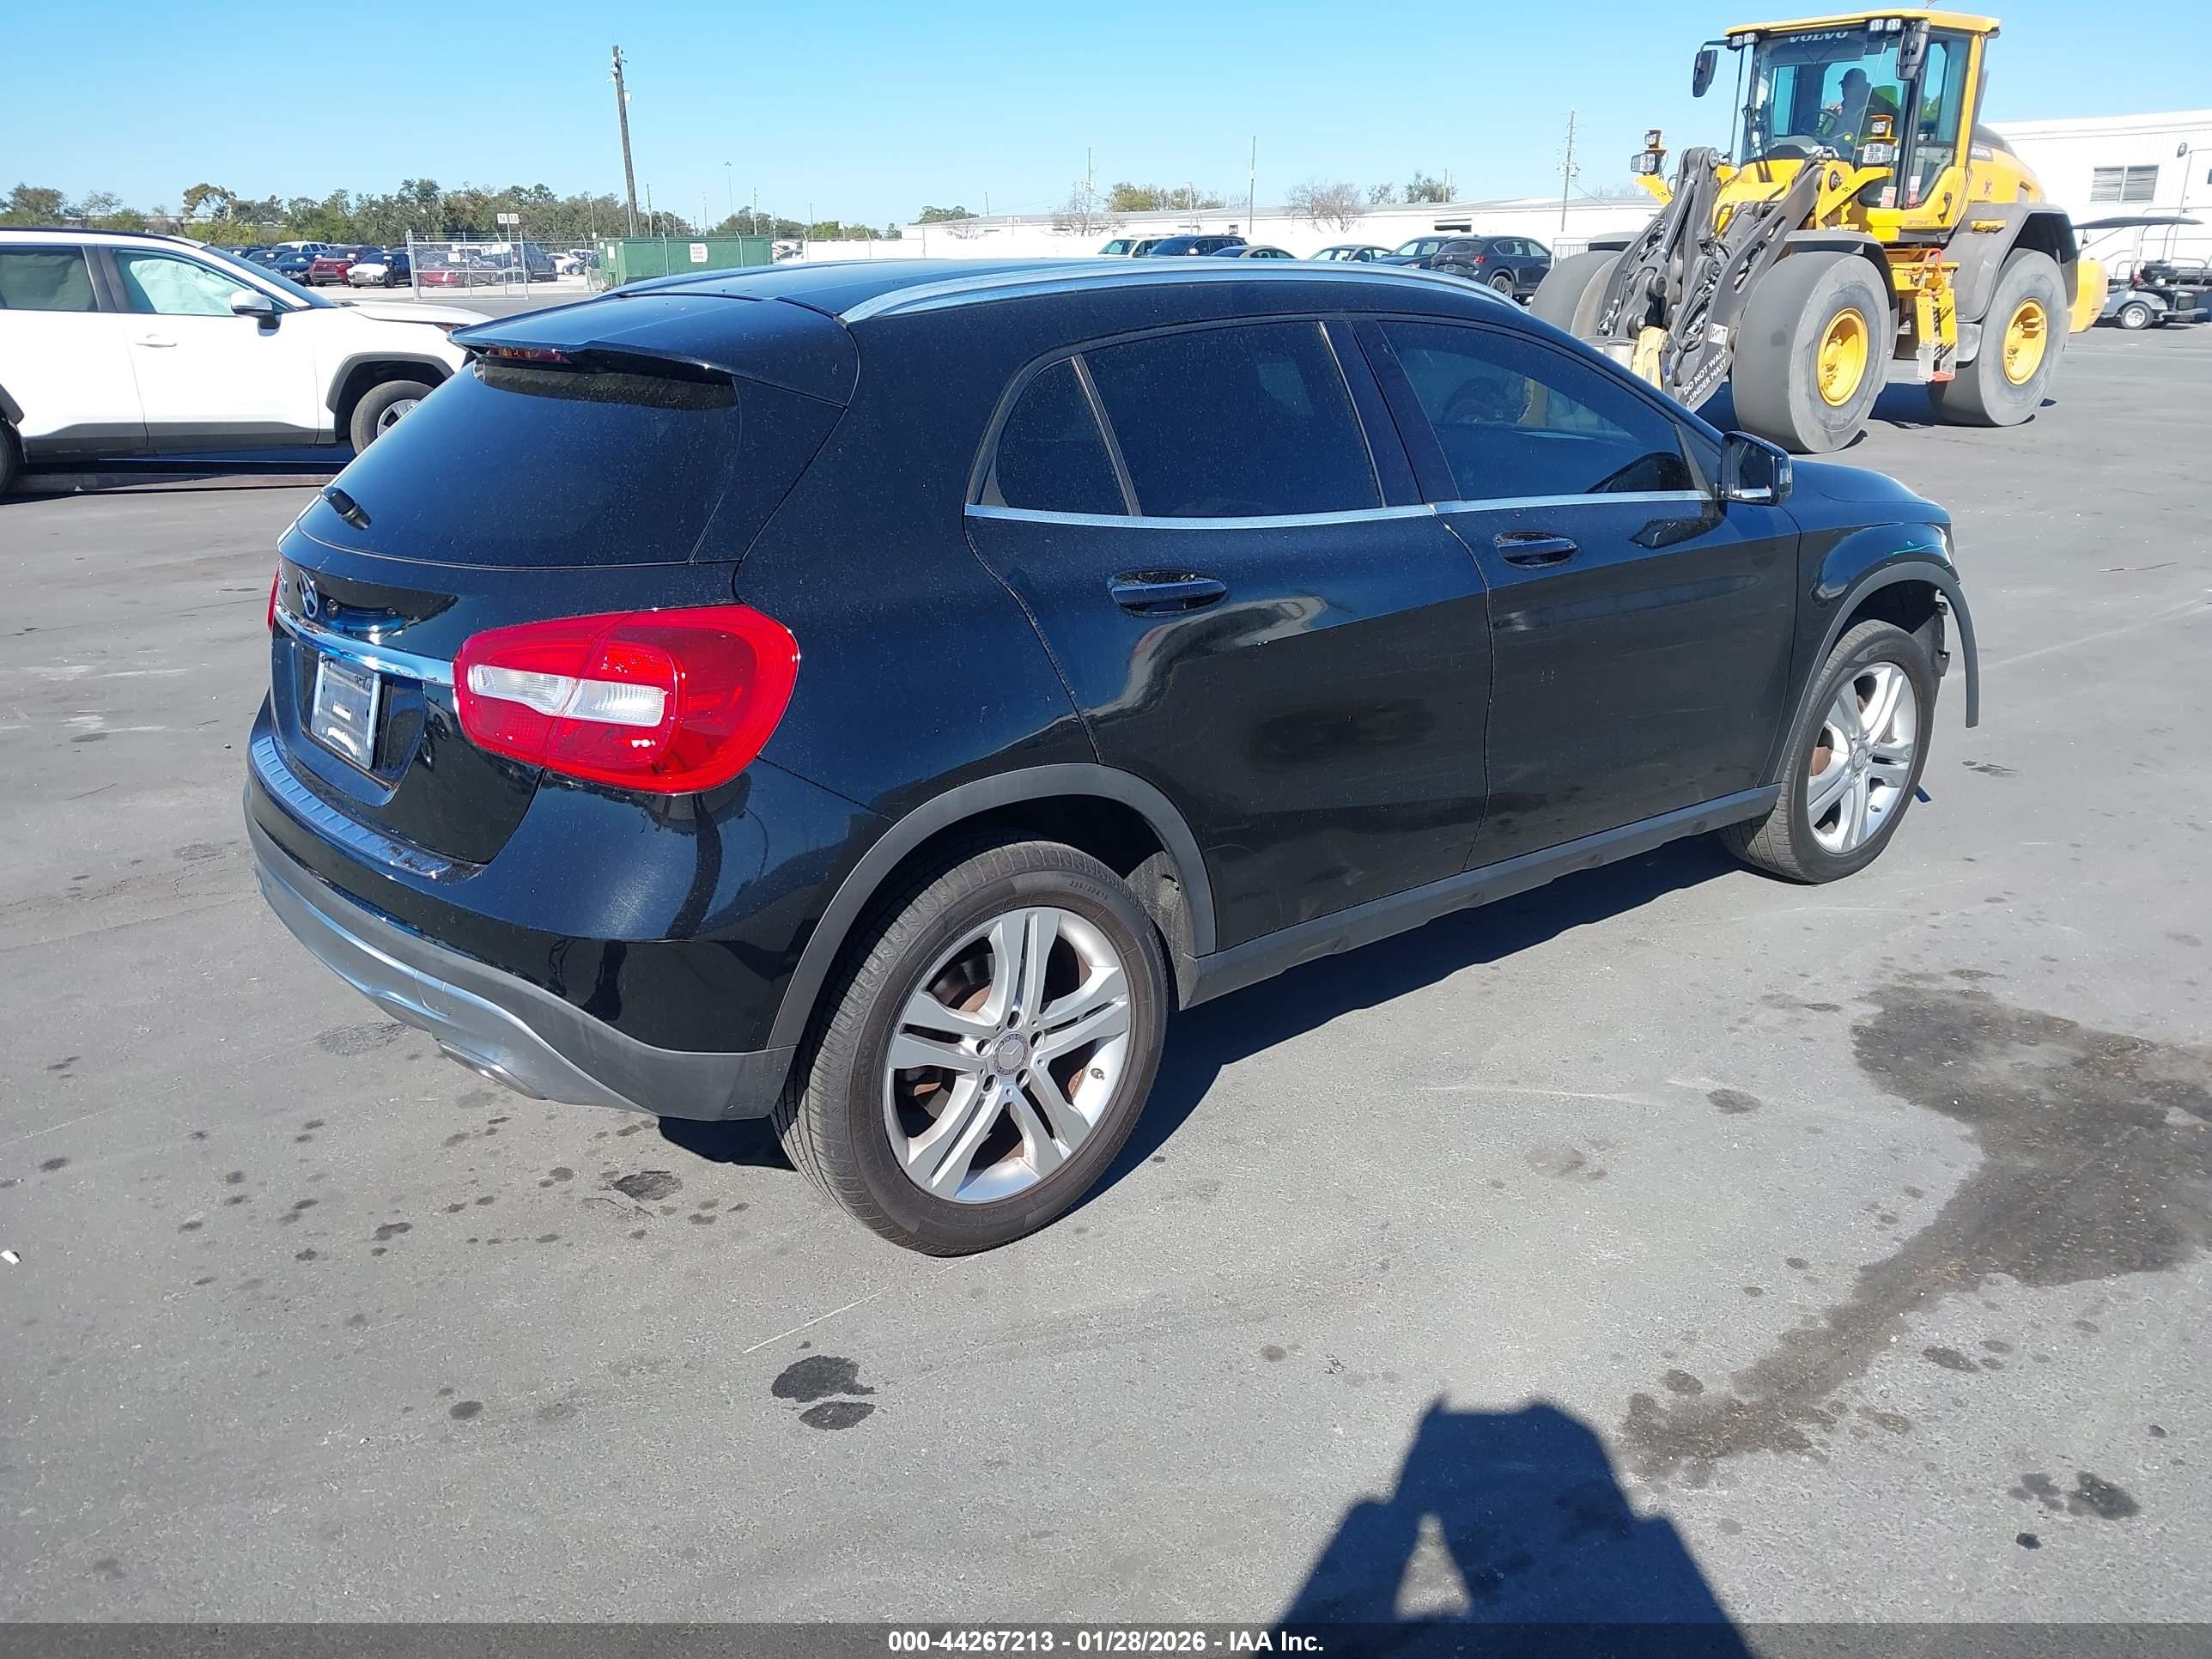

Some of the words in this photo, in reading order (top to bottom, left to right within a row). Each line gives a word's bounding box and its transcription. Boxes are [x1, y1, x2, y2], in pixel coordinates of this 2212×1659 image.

[1790, 31, 1849, 43] VOLVO
[1683, 380, 1694, 396] DO
[1694, 365, 1709, 384] NOT
[1708, 347, 1727, 368] WALK
[1689, 377, 1711, 402] UNDER
[1711, 358, 1727, 380] MAST
